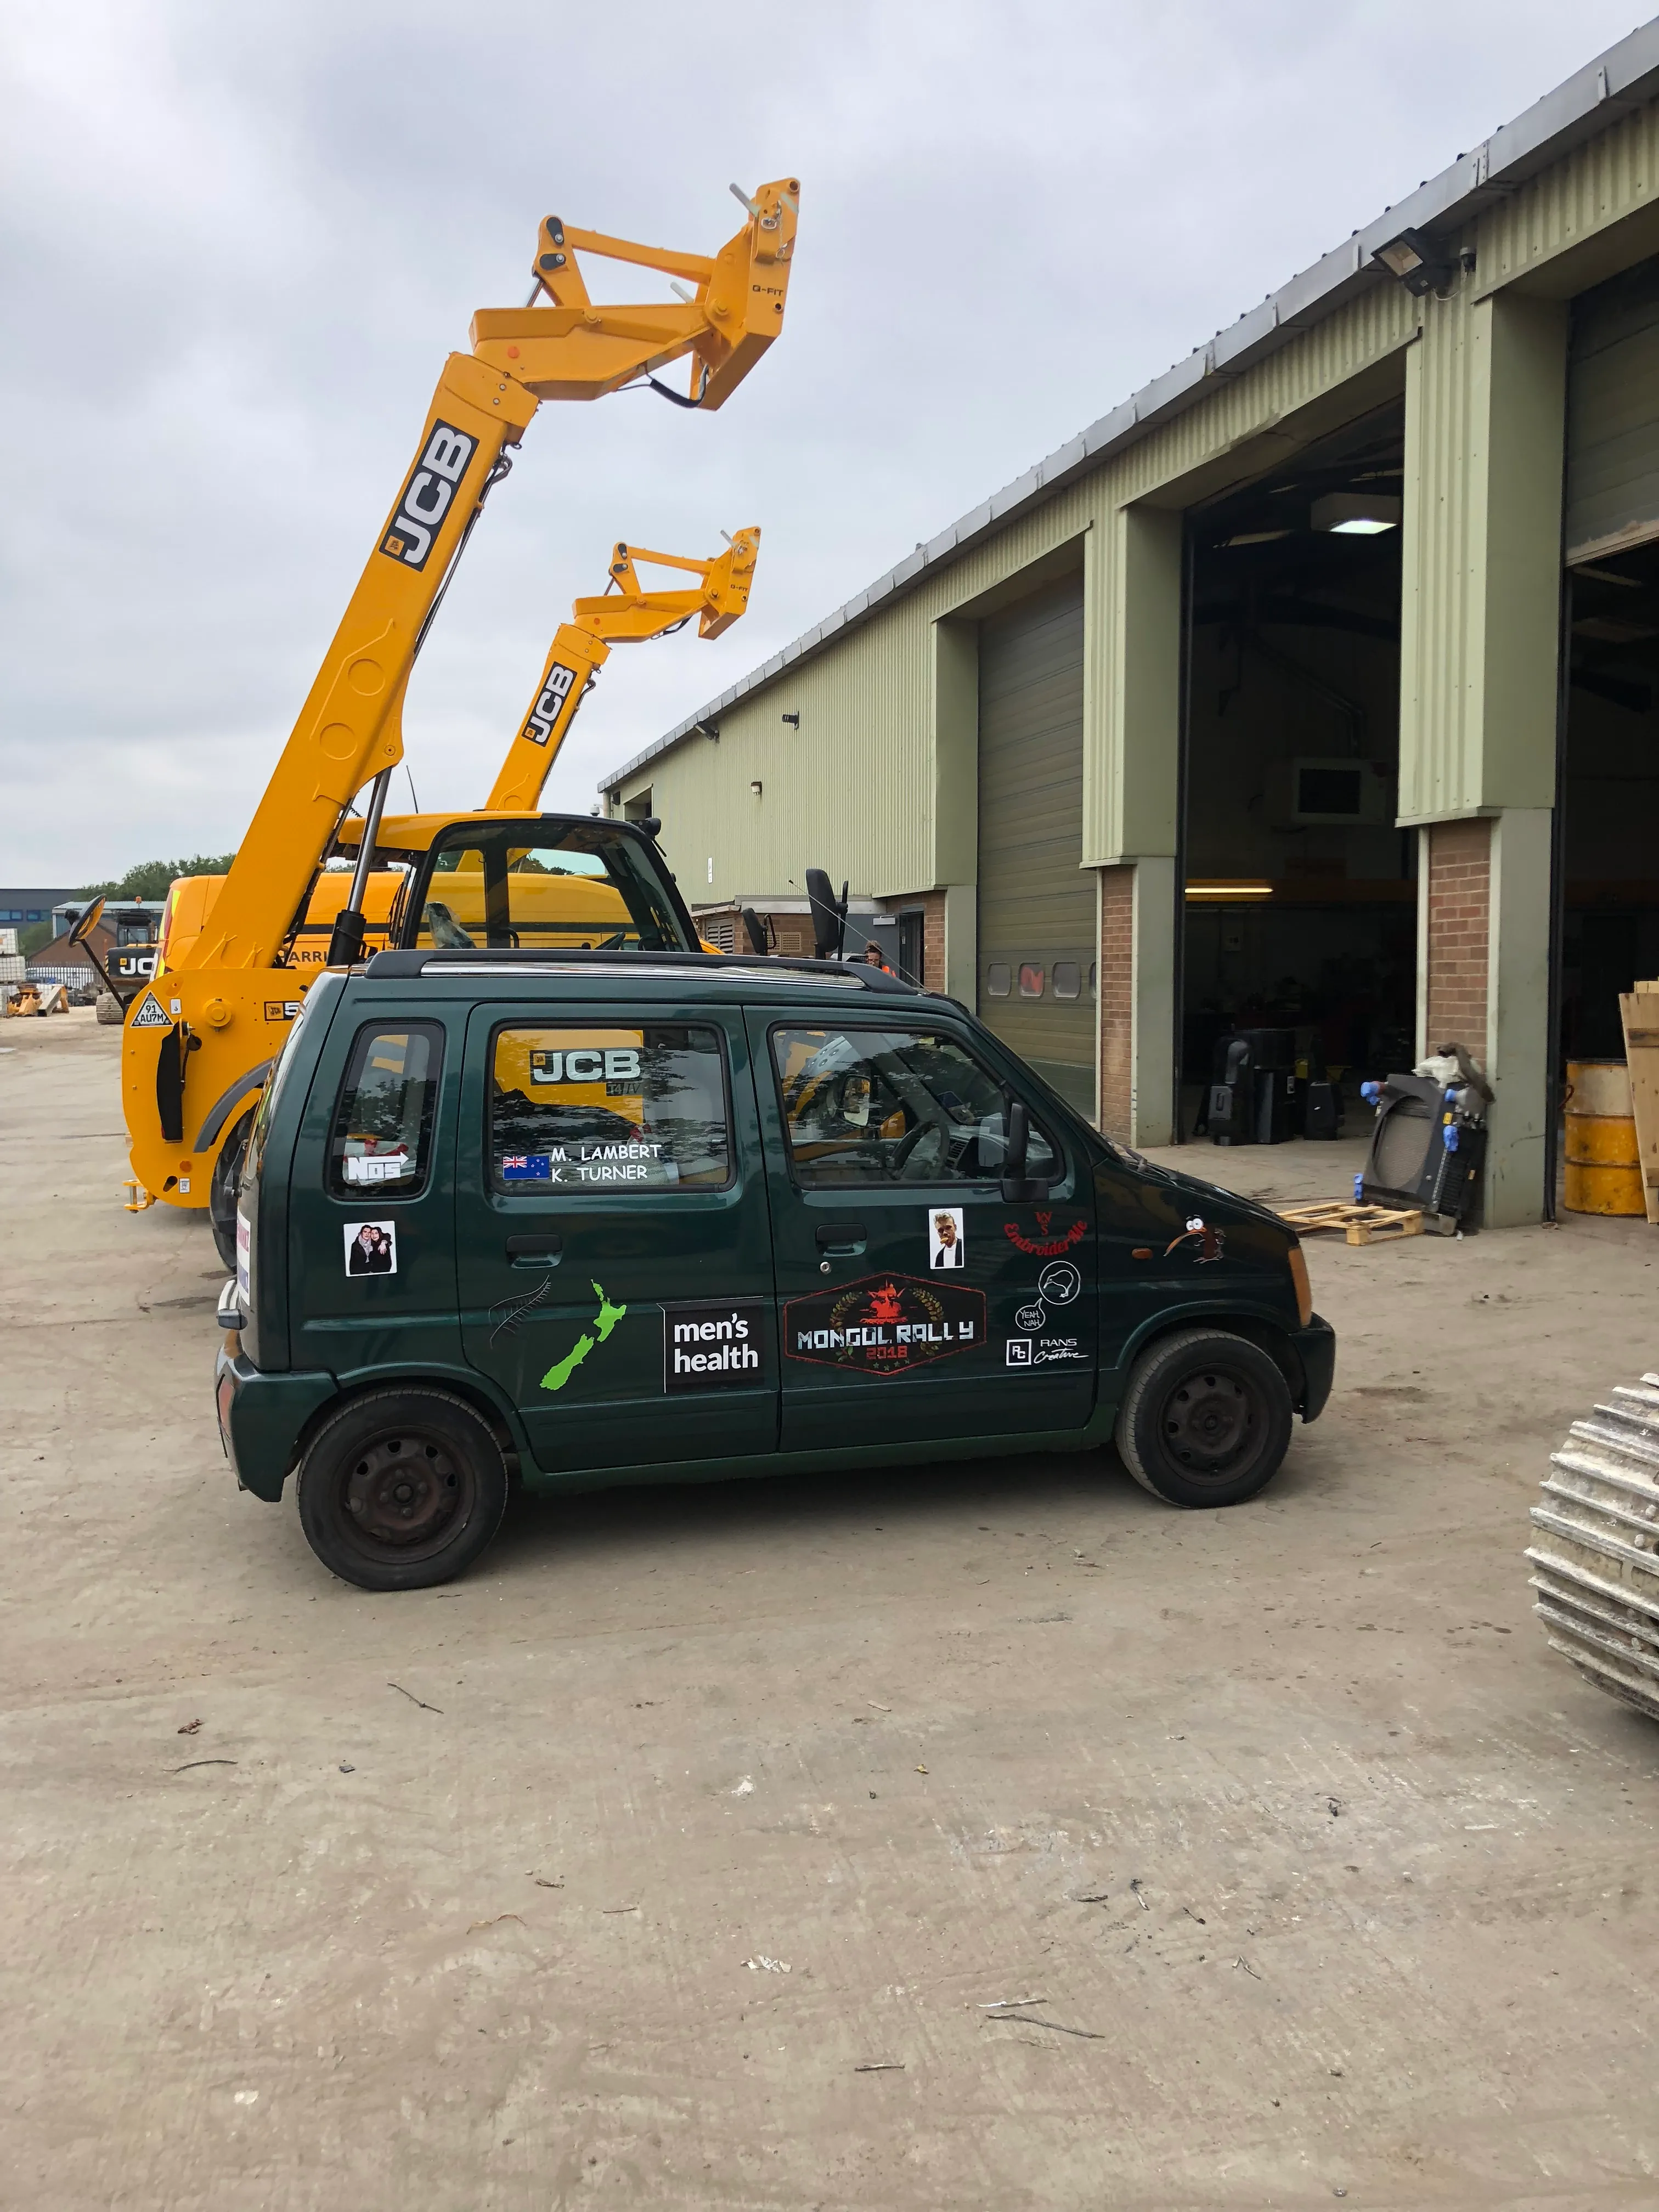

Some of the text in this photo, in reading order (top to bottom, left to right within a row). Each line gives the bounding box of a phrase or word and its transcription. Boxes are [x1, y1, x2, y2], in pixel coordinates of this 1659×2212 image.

[394, 427, 472, 564] JCB
[530, 666, 574, 743] JCB
[280, 950, 327, 962] ARRI
[120, 957, 156, 975] JC
[145, 1005, 157, 1014] 91
[533, 1050, 641, 1082] JCB
[551, 1144, 662, 1162] M. LAMBERT
[551, 1165, 648, 1183] K. TURNER
[674, 1312, 749, 1342] men's
[797, 1321, 974, 1350] MONGOL RALLY
[1040, 1338, 1077, 1347] RANS
[674, 1343, 759, 1373] health
[866, 1345, 909, 1360] 2018
